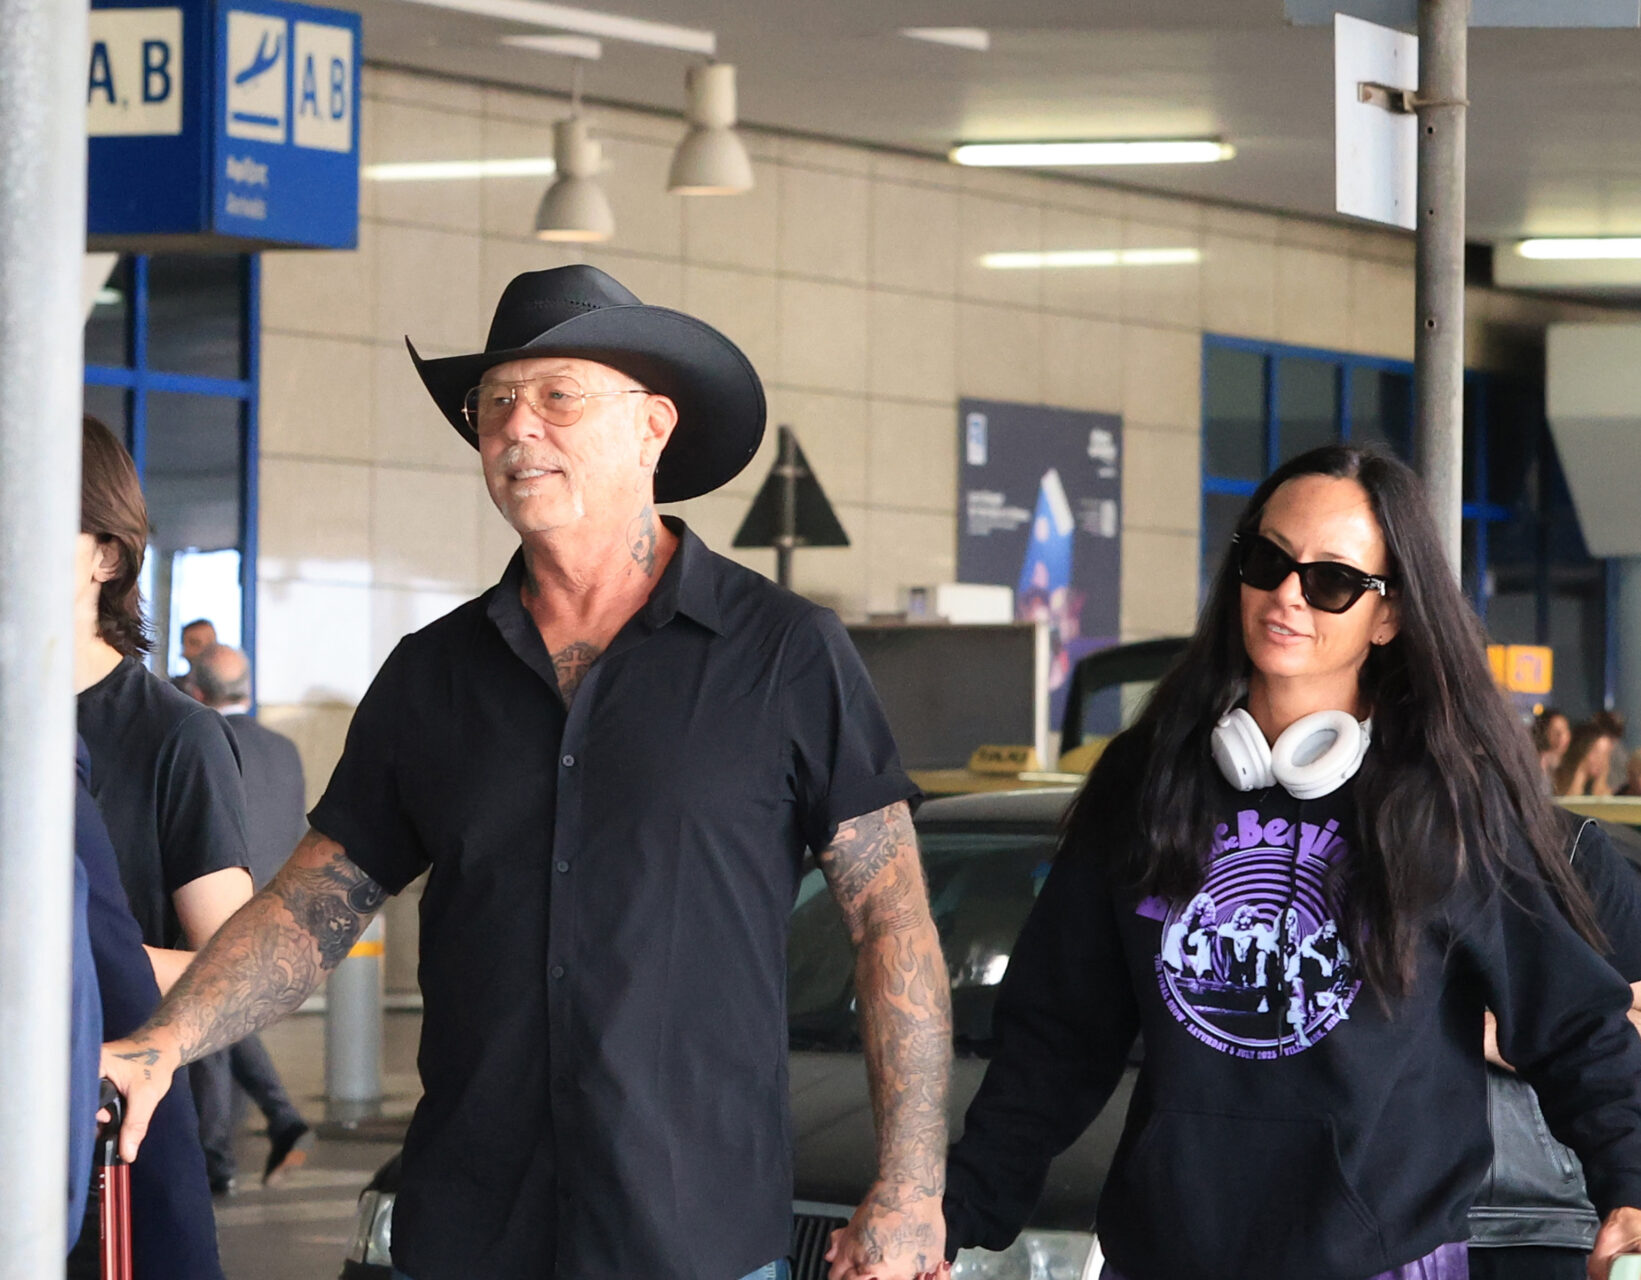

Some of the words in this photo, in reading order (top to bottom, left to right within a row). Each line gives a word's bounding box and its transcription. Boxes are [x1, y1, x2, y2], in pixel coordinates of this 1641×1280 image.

[142, 39, 172, 105] B
[331, 58, 345, 121] B
[1186, 1023, 1229, 1053] SATURDAY
[1235, 1048, 1256, 1059] JULY
